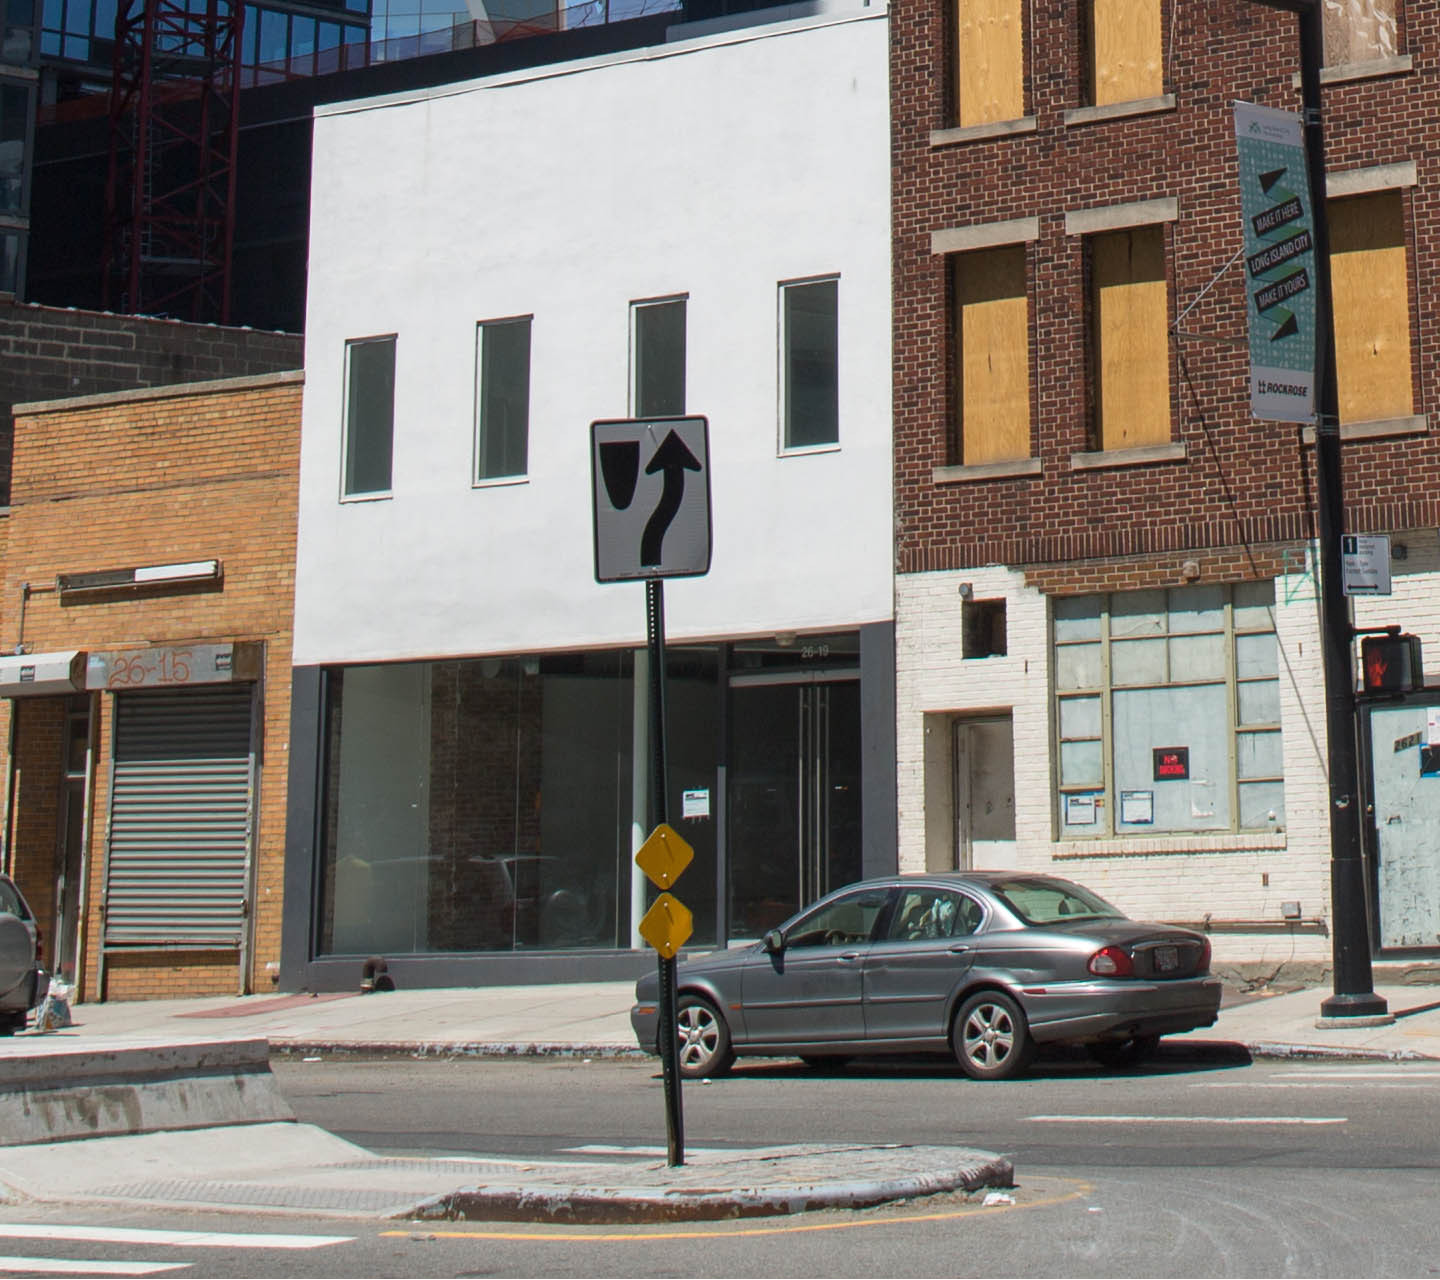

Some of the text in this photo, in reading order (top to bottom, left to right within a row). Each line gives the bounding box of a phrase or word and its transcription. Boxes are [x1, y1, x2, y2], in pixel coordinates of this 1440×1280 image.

[1256, 214, 1275, 232] MAKE
[1281, 202, 1301, 219] HERE
[1250, 234, 1310, 273] LONG ISLAND CITY
[1258, 289, 1277, 308] MAKE
[1282, 274, 1307, 295] YOURS
[1266, 382, 1308, 397] ROCKROSE
[800, 643, 830, 659] 26-19
[111, 650, 193, 686] 26-15
